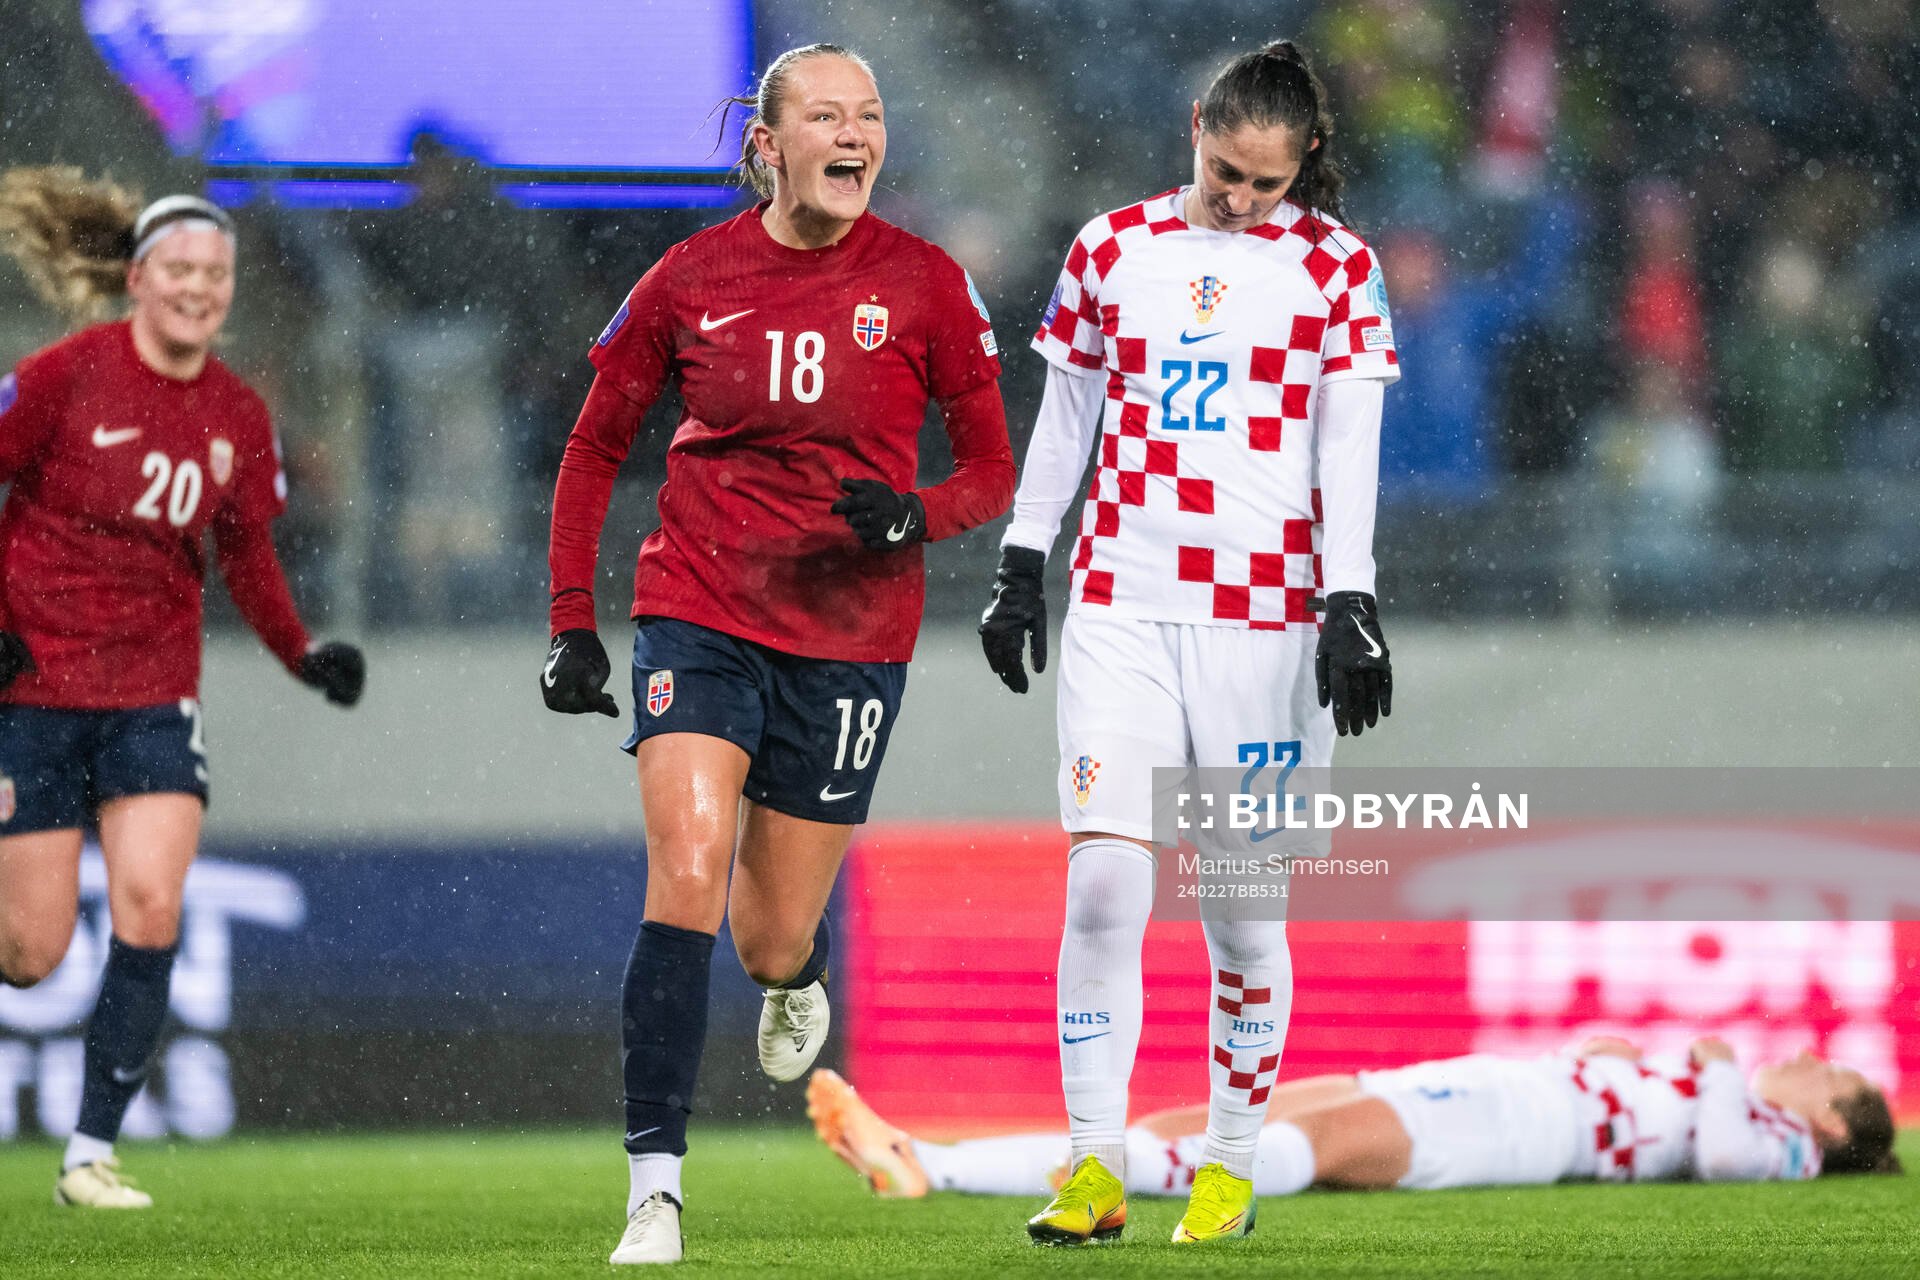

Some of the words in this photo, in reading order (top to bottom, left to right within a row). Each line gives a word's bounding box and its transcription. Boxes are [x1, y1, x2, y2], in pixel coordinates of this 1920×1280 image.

[765, 330, 826, 404] 18
[1160, 359, 1229, 432] 22
[133, 450, 204, 527] 20
[832, 697, 884, 771] 18
[1237, 740, 1307, 813] 22
